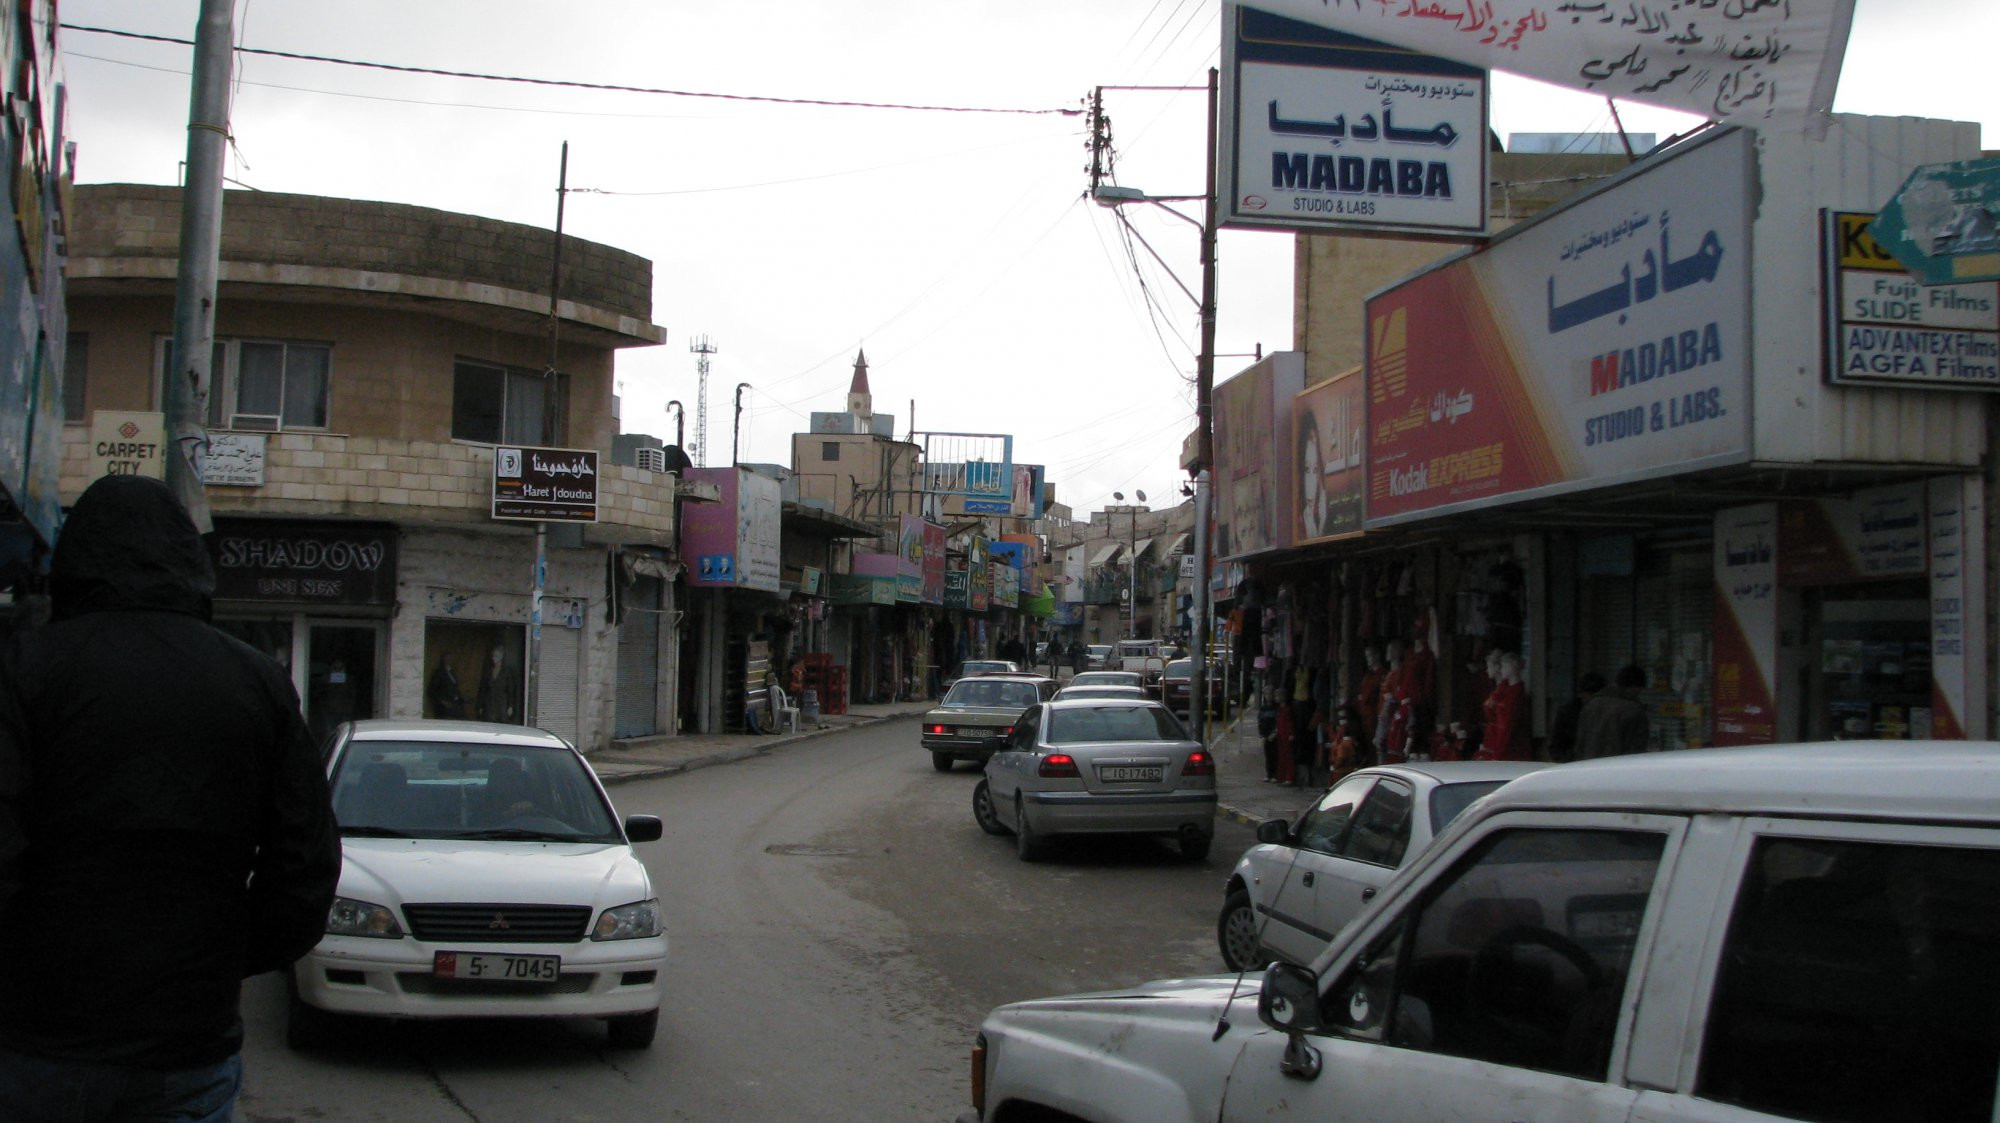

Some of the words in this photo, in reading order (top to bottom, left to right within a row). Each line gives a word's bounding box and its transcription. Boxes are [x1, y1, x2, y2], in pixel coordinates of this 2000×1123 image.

[1364, 76, 1428, 98] ومختبرات
[1429, 83, 1475, 100] ستوديو
[1268, 97, 1460, 149] مأدبا
[1271, 151, 1453, 200] MADABA
[1293, 197, 1333, 213] STUDIO
[1335, 199, 1344, 214] &
[1346, 199, 1376, 216] LABS
[1547, 210, 1725, 334] مأدبا
[1874, 279, 1918, 301] Fuji
[1929, 289, 1991, 312] Films
[1854, 299, 1921, 321] SLIDE
[1849, 328, 1956, 355] ADVANTEX
[1956, 333, 1998, 358] Films
[1590, 321, 1722, 397] MADABA
[1849, 353, 1927, 376] AGFA
[1935, 357, 1997, 379] Films
[1584, 405, 1645, 447] STUDIO
[1649, 401, 1665, 433] &
[1669, 386, 1727, 429] LABS.
[96, 442, 157, 459] CARPET
[107, 460, 141, 476] CITY
[570, 456, 595, 479] حارة
[1389, 462, 1429, 497] Kodak
[1428, 441, 1504, 489] EXPRESS
[522, 483, 550, 498] Haret
[553, 485, 593, 503] Jdoudna
[220, 536, 385, 572] SHADOW
[256, 577, 298, 596] UNI
[302, 578, 344, 597] SEX
[503, 958, 555, 978] 7045
